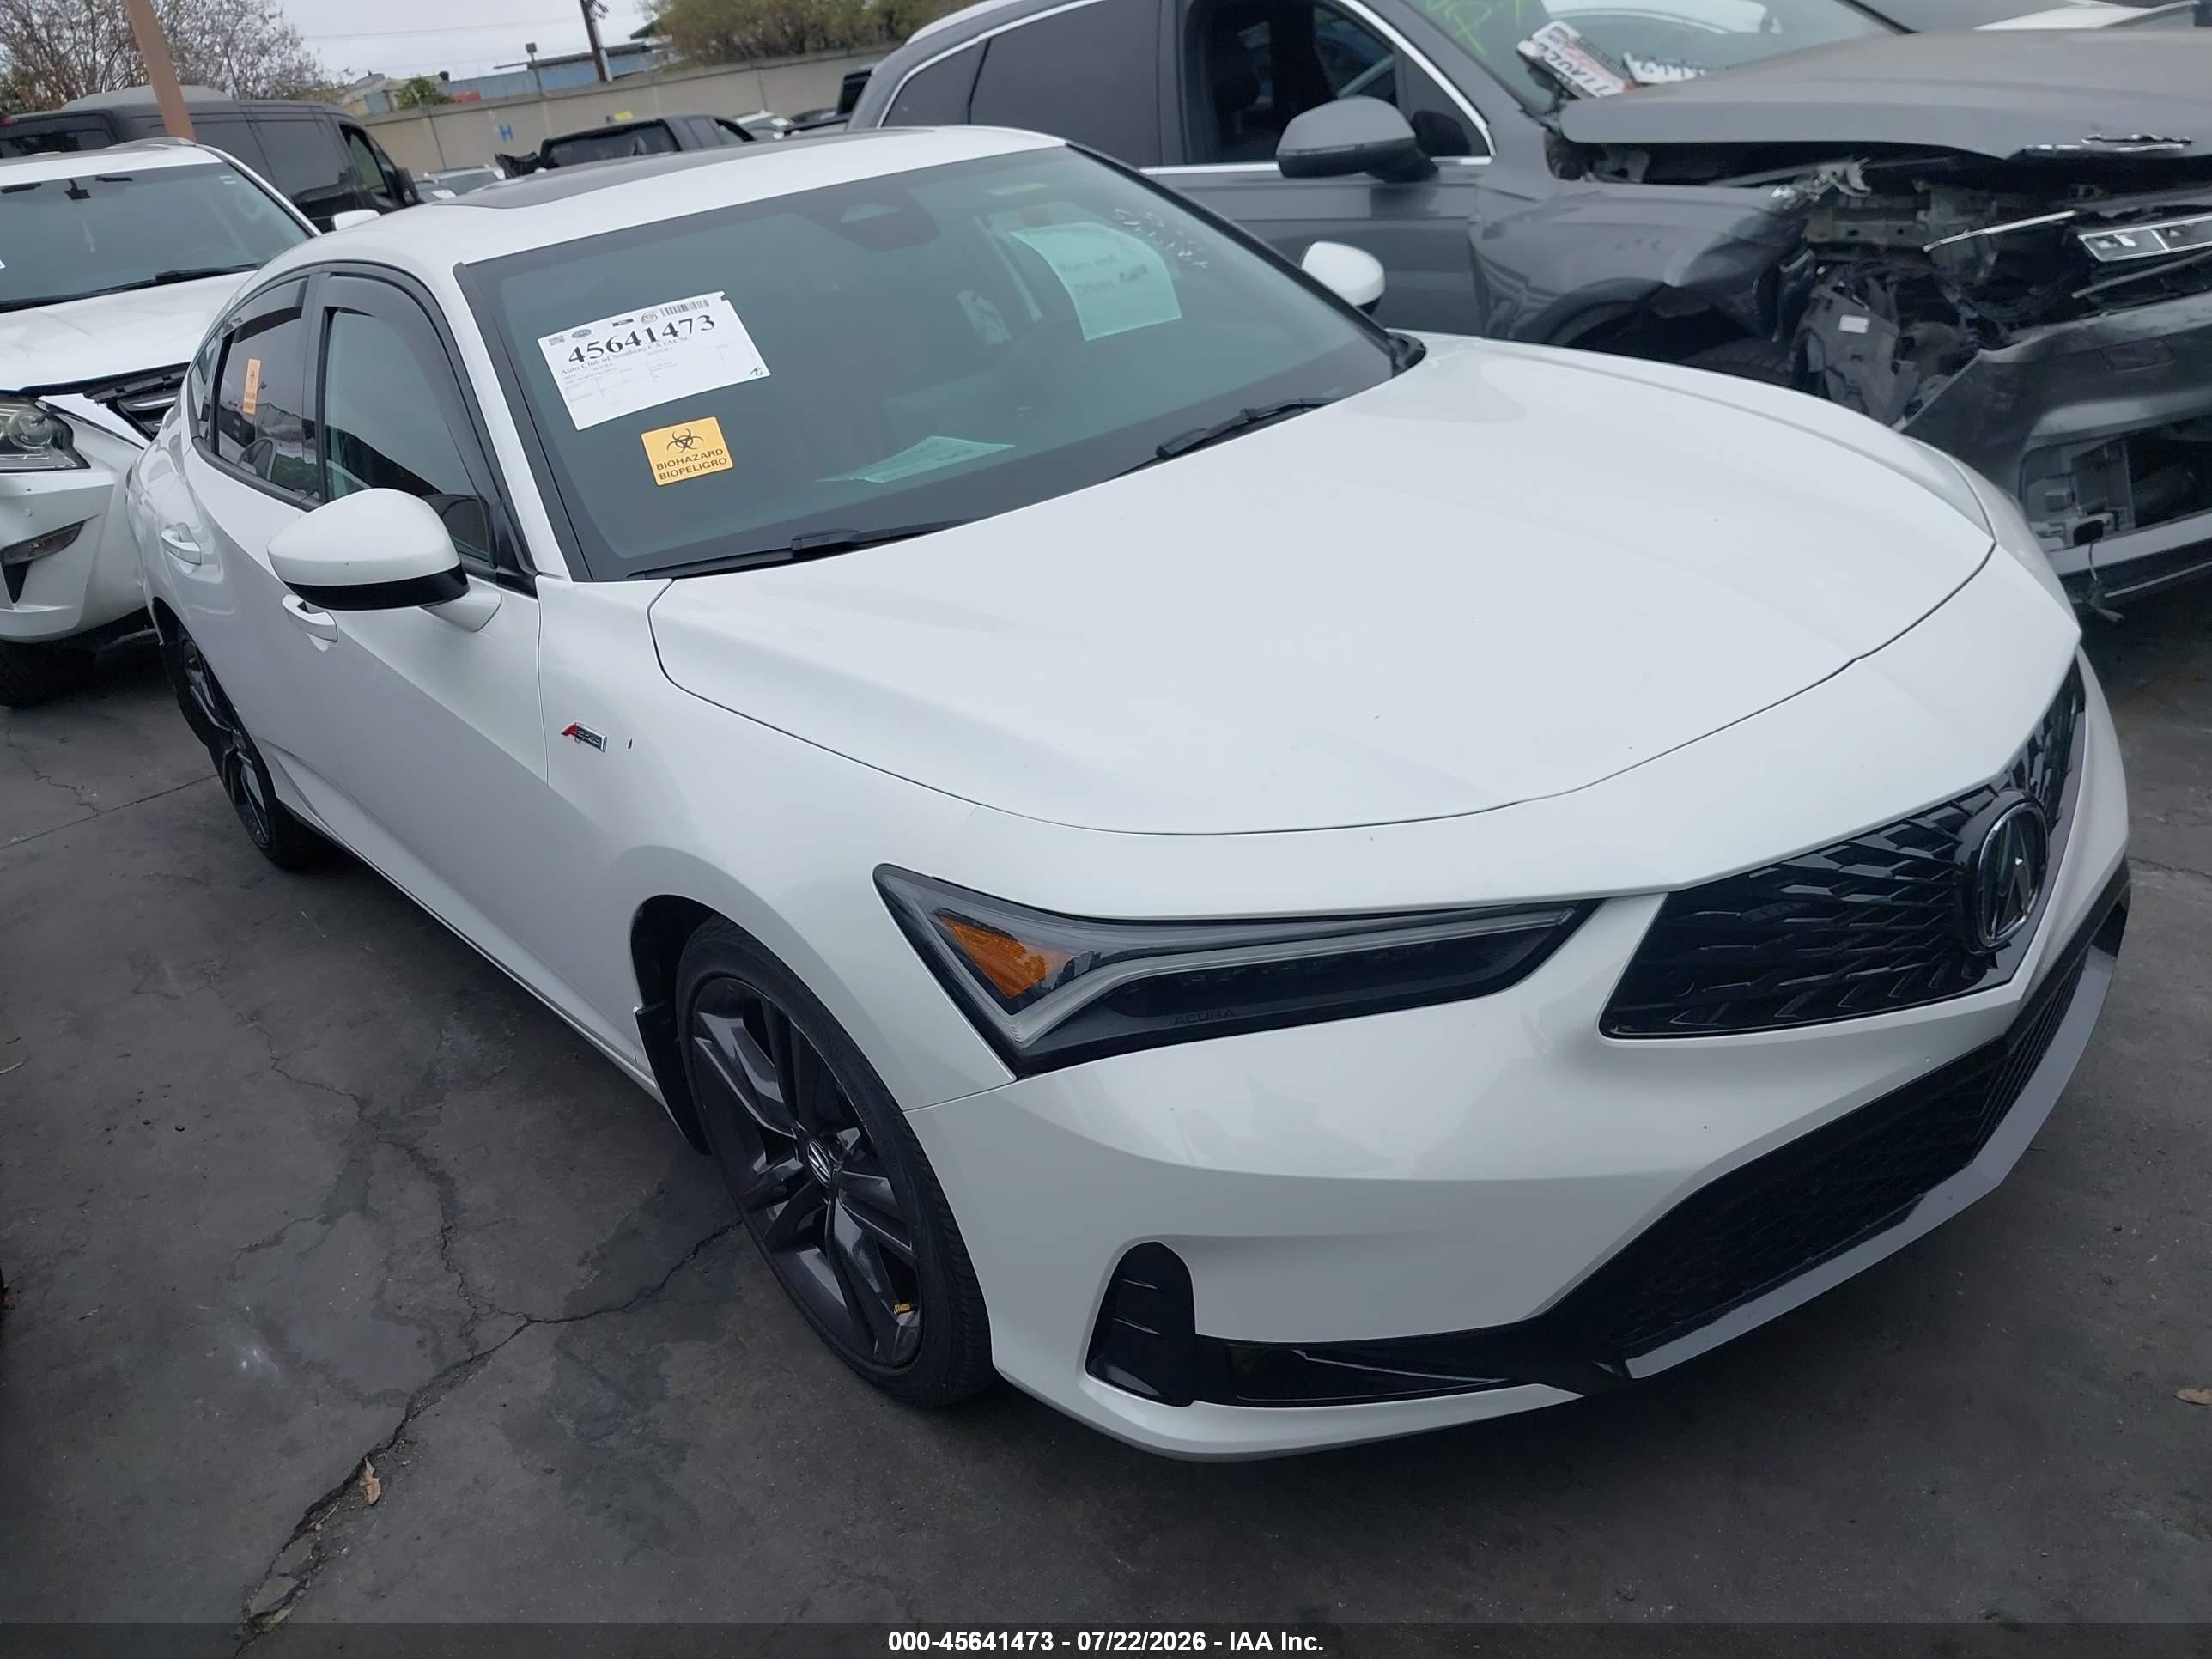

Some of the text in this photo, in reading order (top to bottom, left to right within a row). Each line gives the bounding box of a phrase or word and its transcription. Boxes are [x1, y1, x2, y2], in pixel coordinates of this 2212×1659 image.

[568, 314, 715, 363] 45641473
[562, 365, 580, 374] Auto
[580, 359, 600, 368] Club
[656, 448, 724, 471] BIOHAZARD
[659, 457, 727, 481] BIOPELIGRO
[1174, 1009, 1237, 1025] ACURA
